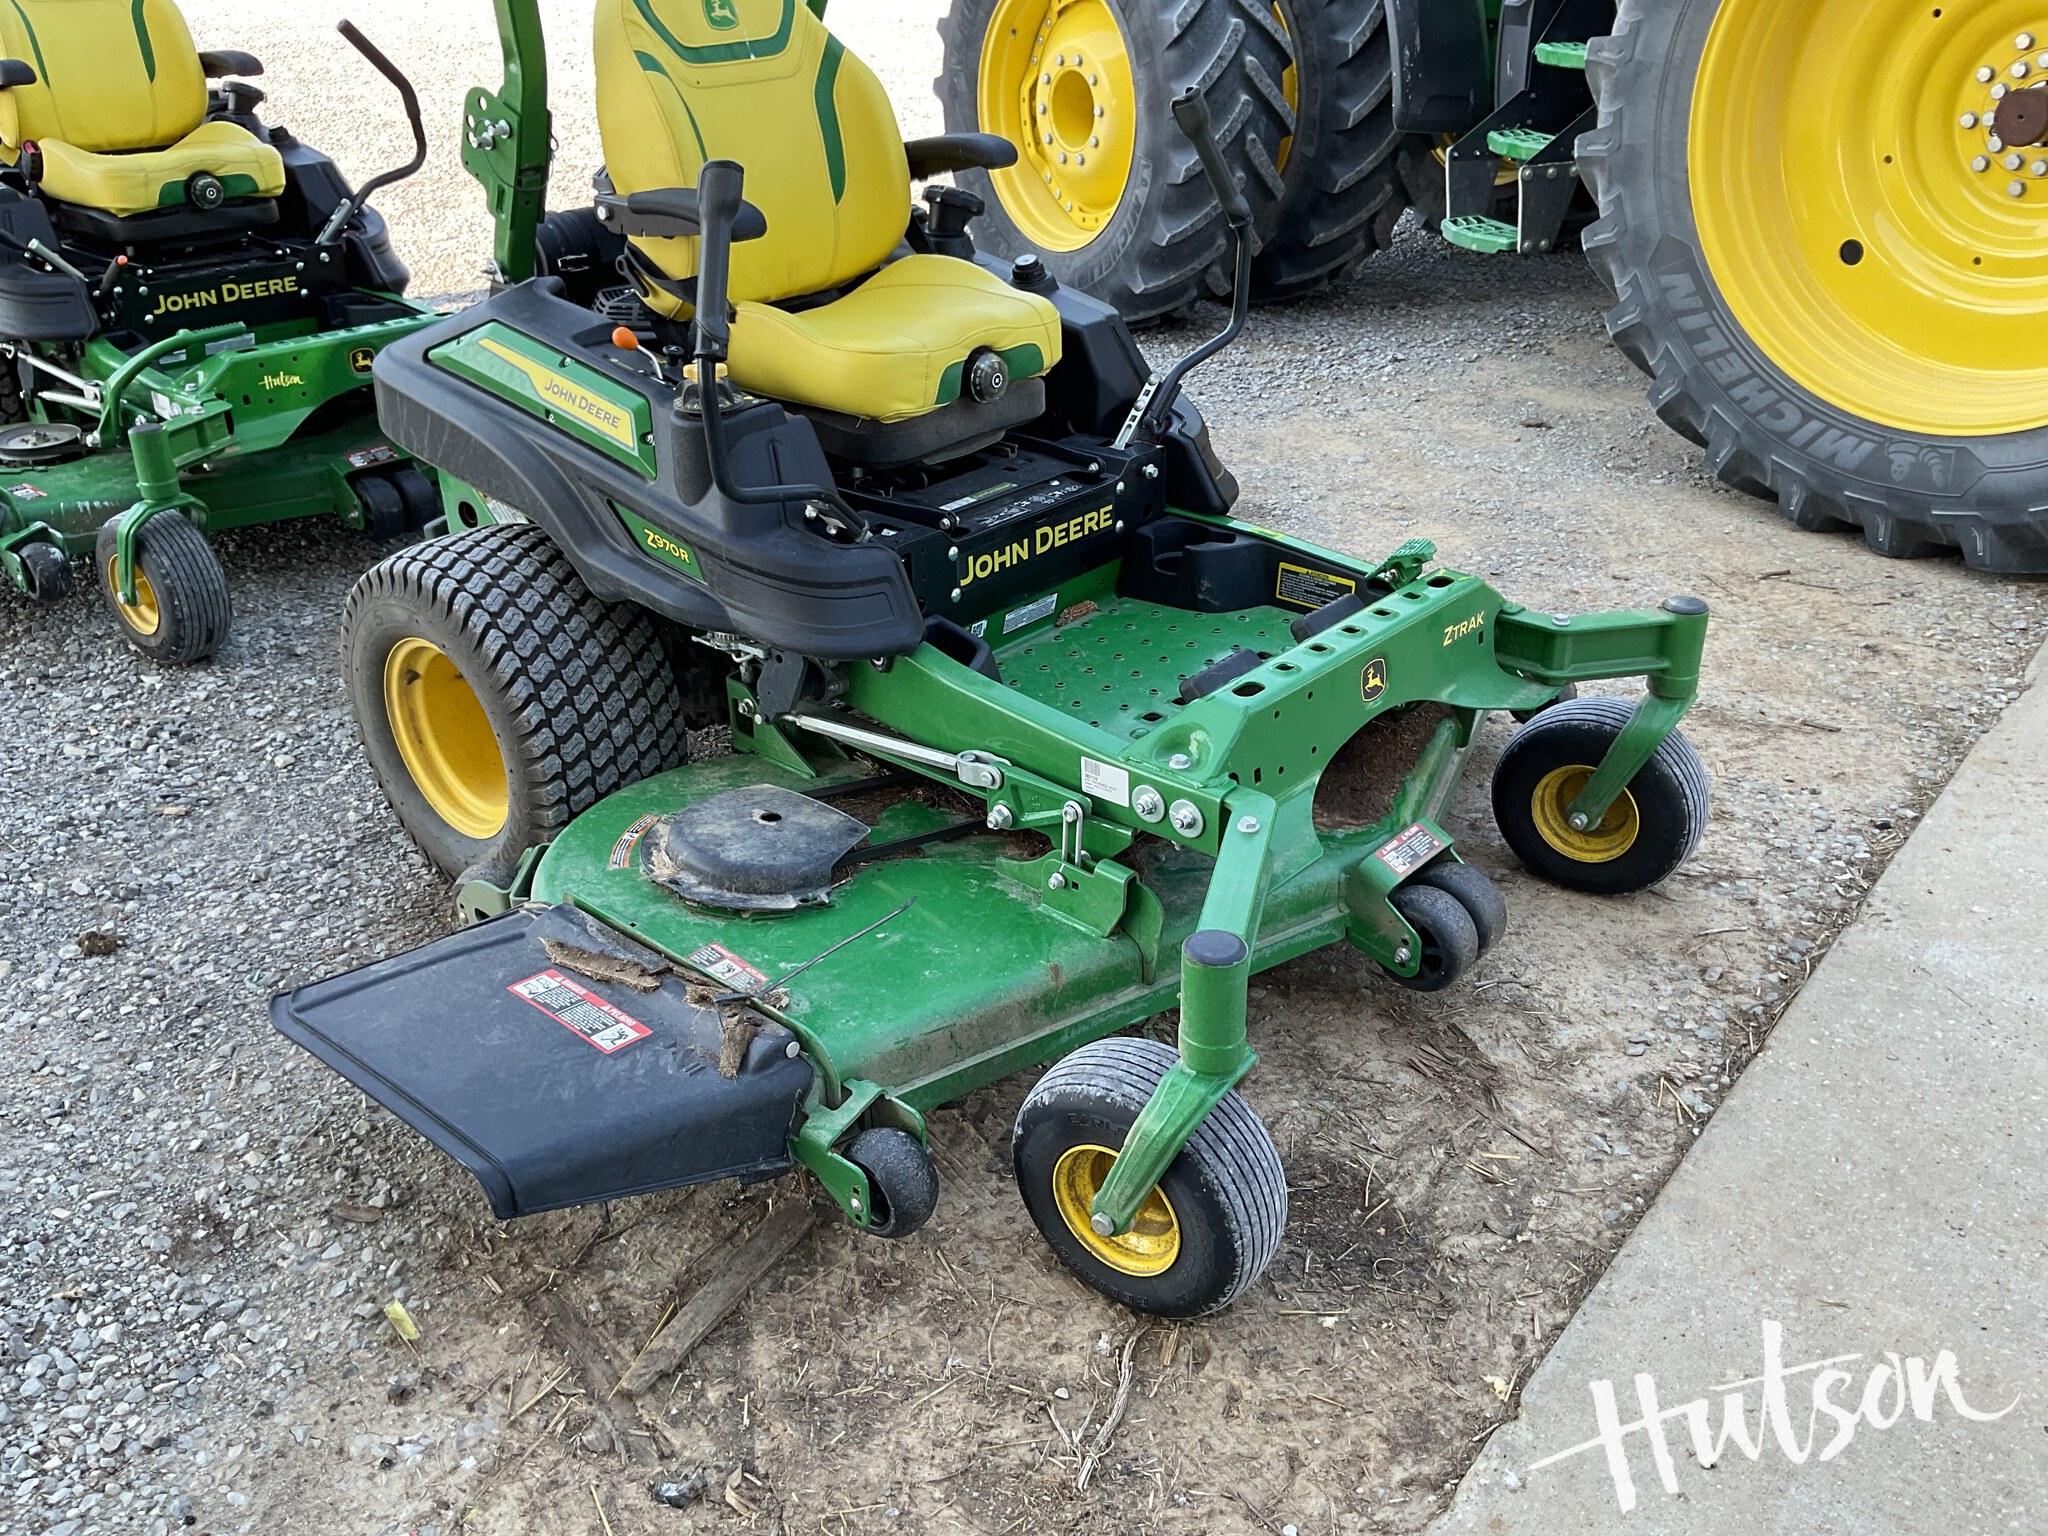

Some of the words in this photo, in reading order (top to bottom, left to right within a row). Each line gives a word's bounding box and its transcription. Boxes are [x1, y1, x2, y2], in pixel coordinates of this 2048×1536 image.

[153, 289, 218, 315] JOHN
[221, 276, 299, 303] DEERE
[258, 371, 305, 391] Hutson
[1658, 272, 1880, 470] MICHELIN
[544, 379, 577, 405] JOHN
[578, 395, 621, 429] DEERE
[643, 528, 691, 564] Z970R
[960, 538, 1029, 587] JOHN
[1035, 504, 1113, 556] DEERE
[1443, 610, 1485, 647] ZTRAK
[607, 1008, 637, 1027] PELIGRO
